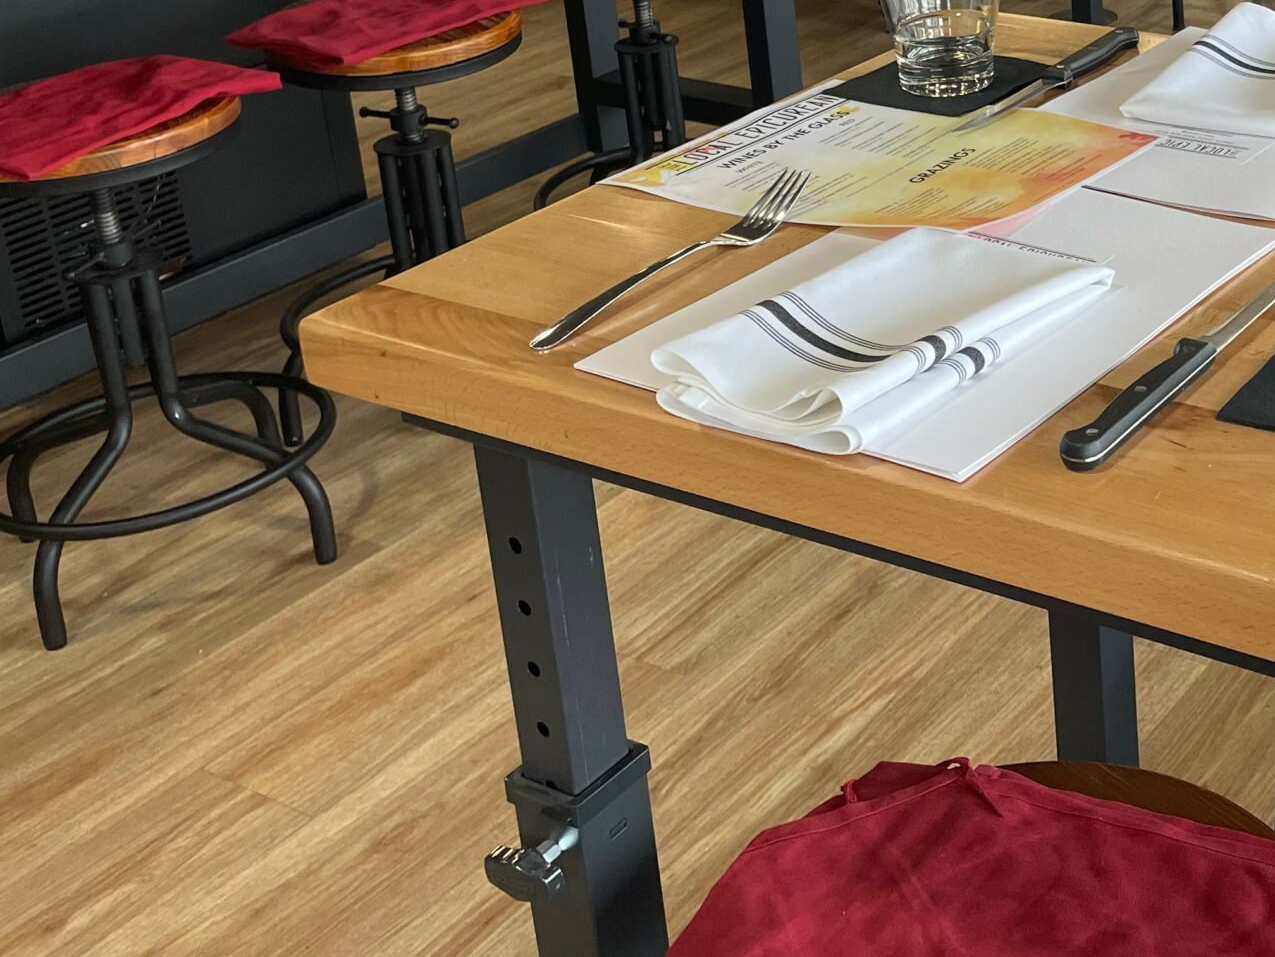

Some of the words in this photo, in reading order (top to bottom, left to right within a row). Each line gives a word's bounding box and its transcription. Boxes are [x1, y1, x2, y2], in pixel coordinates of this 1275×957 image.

[671, 140, 744, 166] LOCAL
[734, 94, 841, 140] EPICUREAN
[716, 148, 767, 170] WINES
[762, 139, 785, 151] BY
[781, 128, 812, 141] THE
[807, 110, 850, 130] GLASS
[908, 147, 976, 184] GRAZINGS
